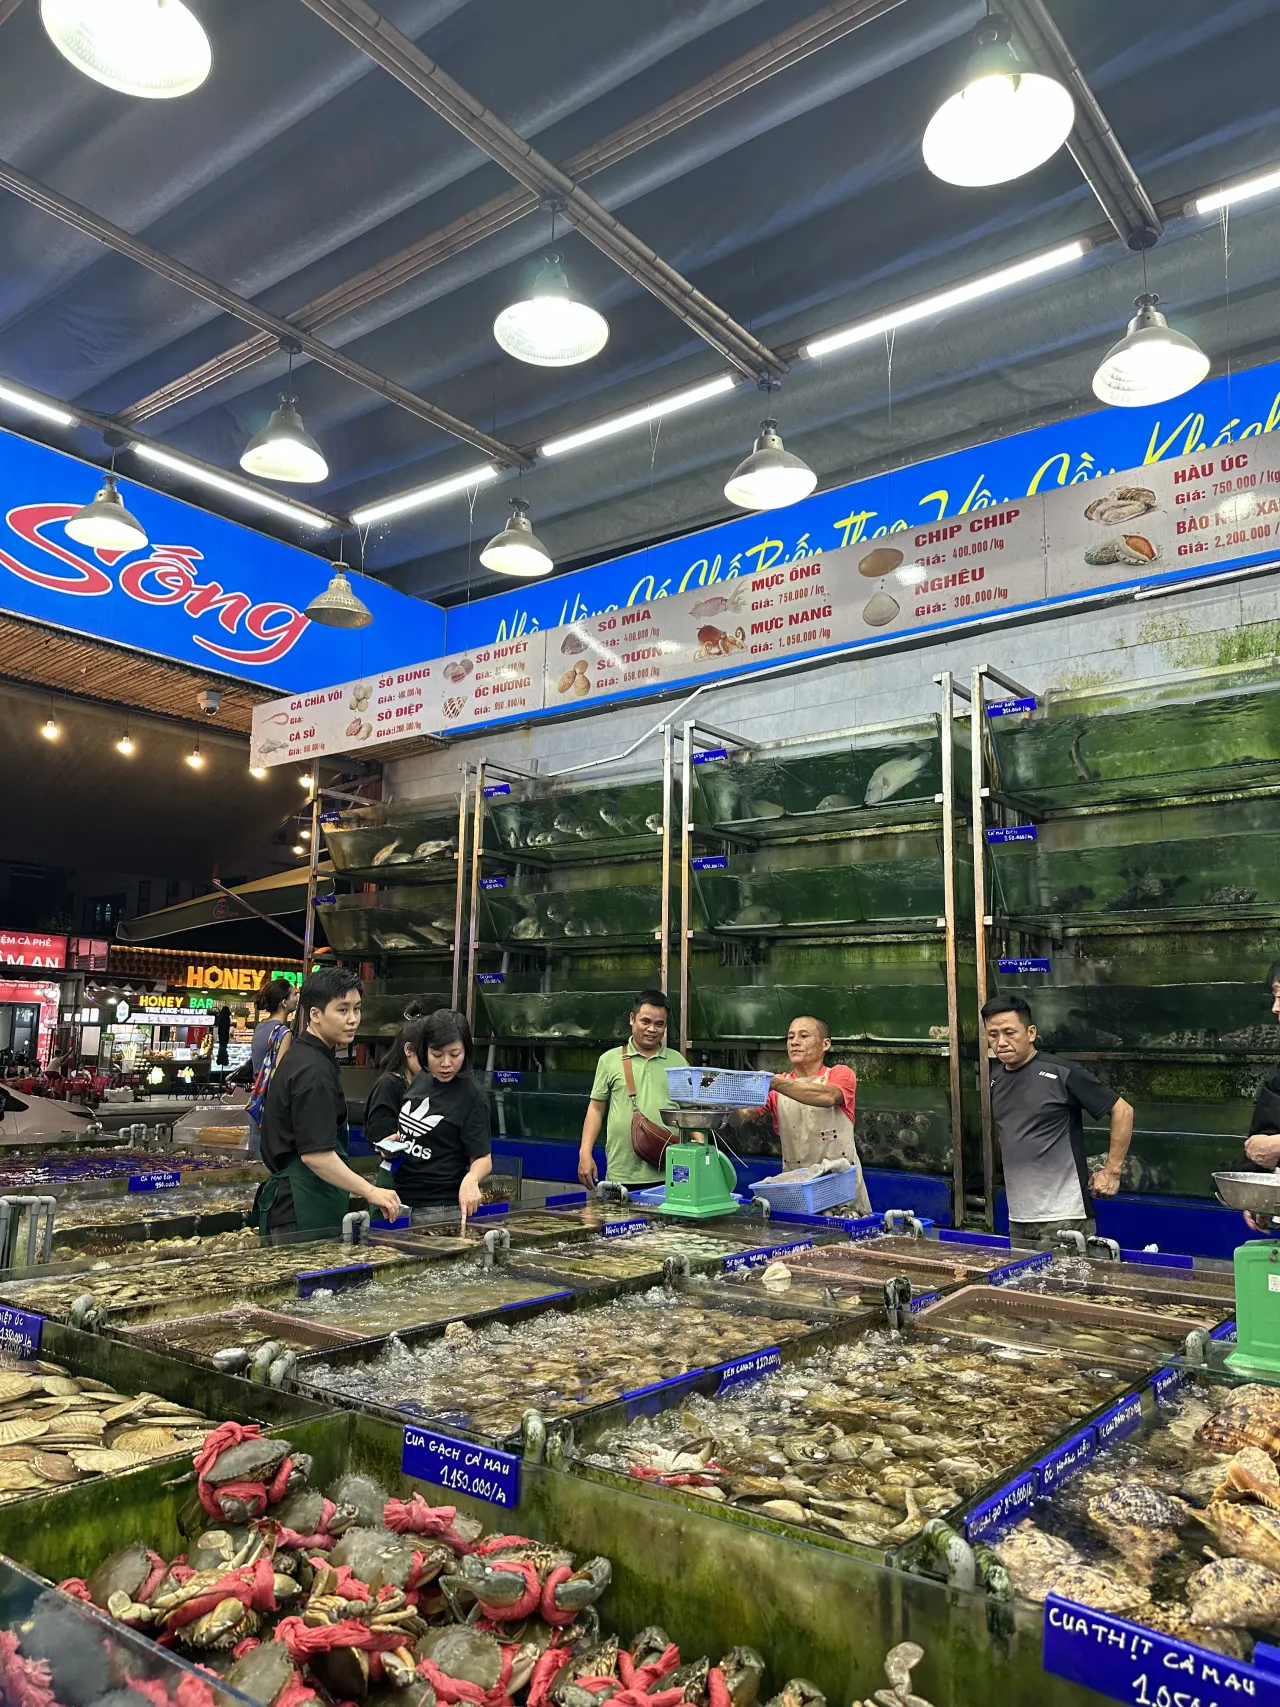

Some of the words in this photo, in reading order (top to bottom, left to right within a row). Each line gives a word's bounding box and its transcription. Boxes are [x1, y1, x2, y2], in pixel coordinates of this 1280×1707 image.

[1173, 461, 1214, 485] HÀU
[1220, 453, 1249, 472] ÚC
[1175, 489, 1206, 505] Giá:
[914, 524, 963, 548] CHIP
[969, 509, 1020, 533] CHIP
[1176, 515, 1209, 535] BÀO
[558, 592, 619, 627] Hà
[1026, 452, 1116, 497] Cầ
[1177, 540, 1209, 556] Giá:
[751, 573, 785, 593] MỰC
[789, 562, 821, 581] ỐNG
[914, 566, 985, 596] NGHÊU
[751, 599, 774, 611] Giá:
[914, 604, 947, 617] Giá:
[597, 616, 617, 632] SÒ
[621, 609, 652, 626] MÍA
[750, 616, 784, 635] MỰC
[788, 604, 832, 626] NANG
[475, 650, 492, 664] SÒ
[493, 641, 529, 660] HUYẾT
[750, 642, 773, 654] Giá:
[378, 675, 393, 689] SÒ
[397, 667, 431, 684] BUNG
[475, 670, 492, 681] Giá:
[596, 677, 619, 689] Giá:
[474, 685, 490, 699] ỐC
[492, 676, 531, 695] HƯƠNG
[305, 694, 326, 708] CHÌA
[327, 690, 343, 702] VÔI
[377, 694, 396, 705] Giá:
[289, 716, 304, 725] Giá:
[376, 709, 392, 722] SÒ
[395, 702, 424, 718] ĐIỆP
[474, 706, 491, 716] Giá:
[289, 730, 302, 742] CÁ
[288, 747, 302, 756] Giá:
[17, 936, 31, 946] CÀ
[31, 955, 60, 969] AN
[187, 965, 266, 991] HONEY
[139, 995, 184, 1008] HONEY
[189, 997, 214, 1009] BAR
[400, 1134, 432, 1160] das
[405, 1431, 425, 1448] CUA
[428, 1440, 461, 1461] GẠCH
[484, 1458, 510, 1475] MAU
[1201, 1664, 1256, 1696] MAU
